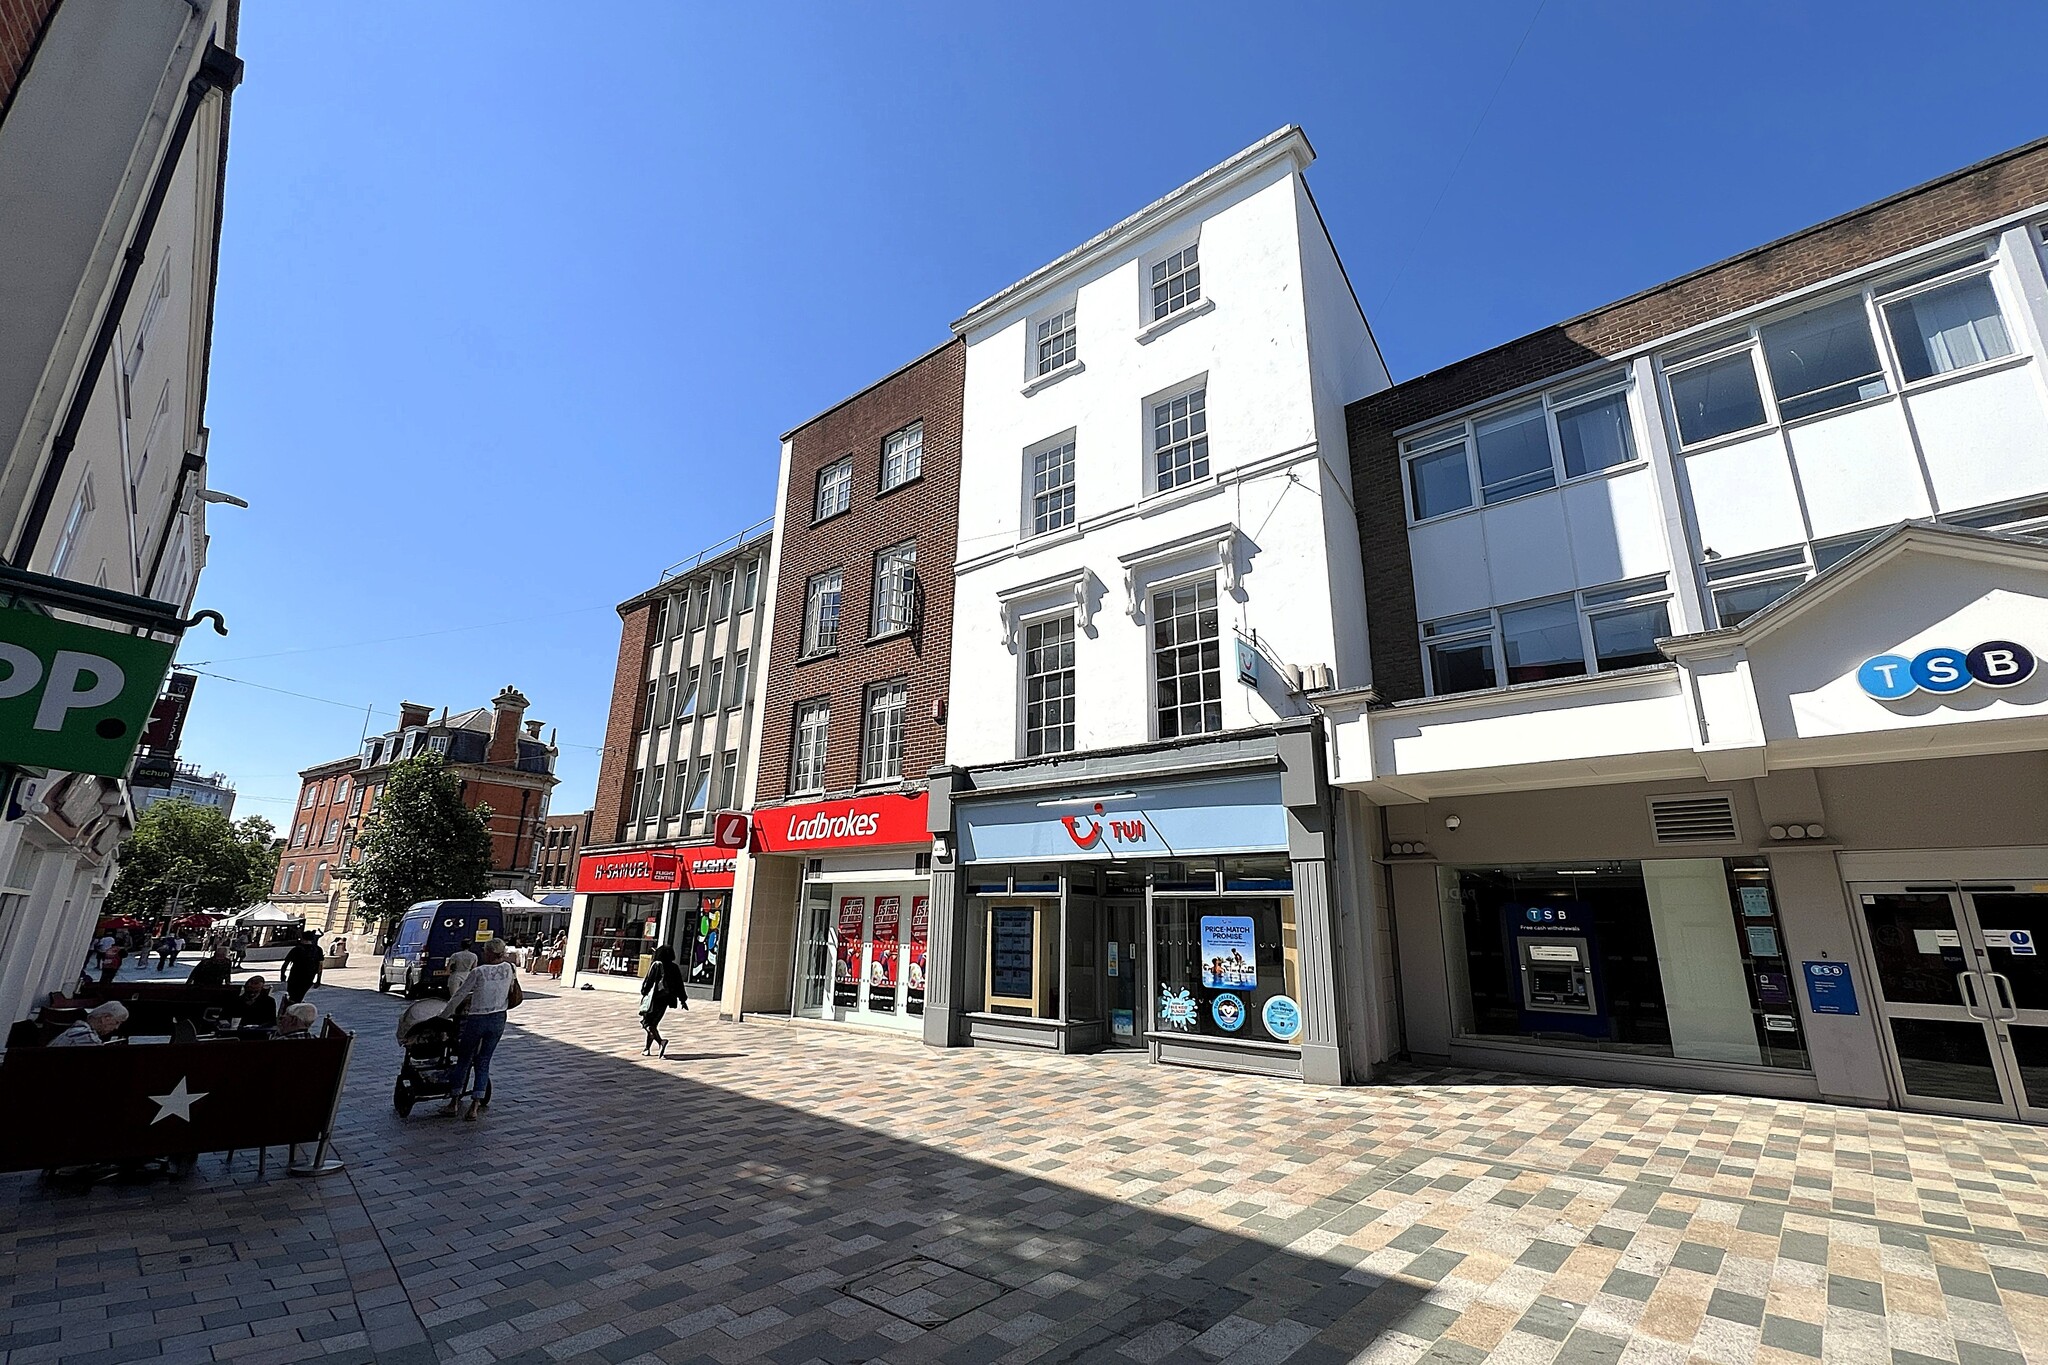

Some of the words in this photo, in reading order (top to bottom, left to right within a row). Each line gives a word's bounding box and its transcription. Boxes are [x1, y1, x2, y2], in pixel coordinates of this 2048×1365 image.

[1873, 649, 2019, 688] TSB
[787, 808, 880, 841] Ladbrokes
[1109, 820, 1145, 841] TUI
[692, 859, 725, 873] FLIGHT
[1530, 910, 1567, 920] TSB
[1204, 926, 1250, 934] PRICE-MATCH
[603, 957, 629, 972] SALE
